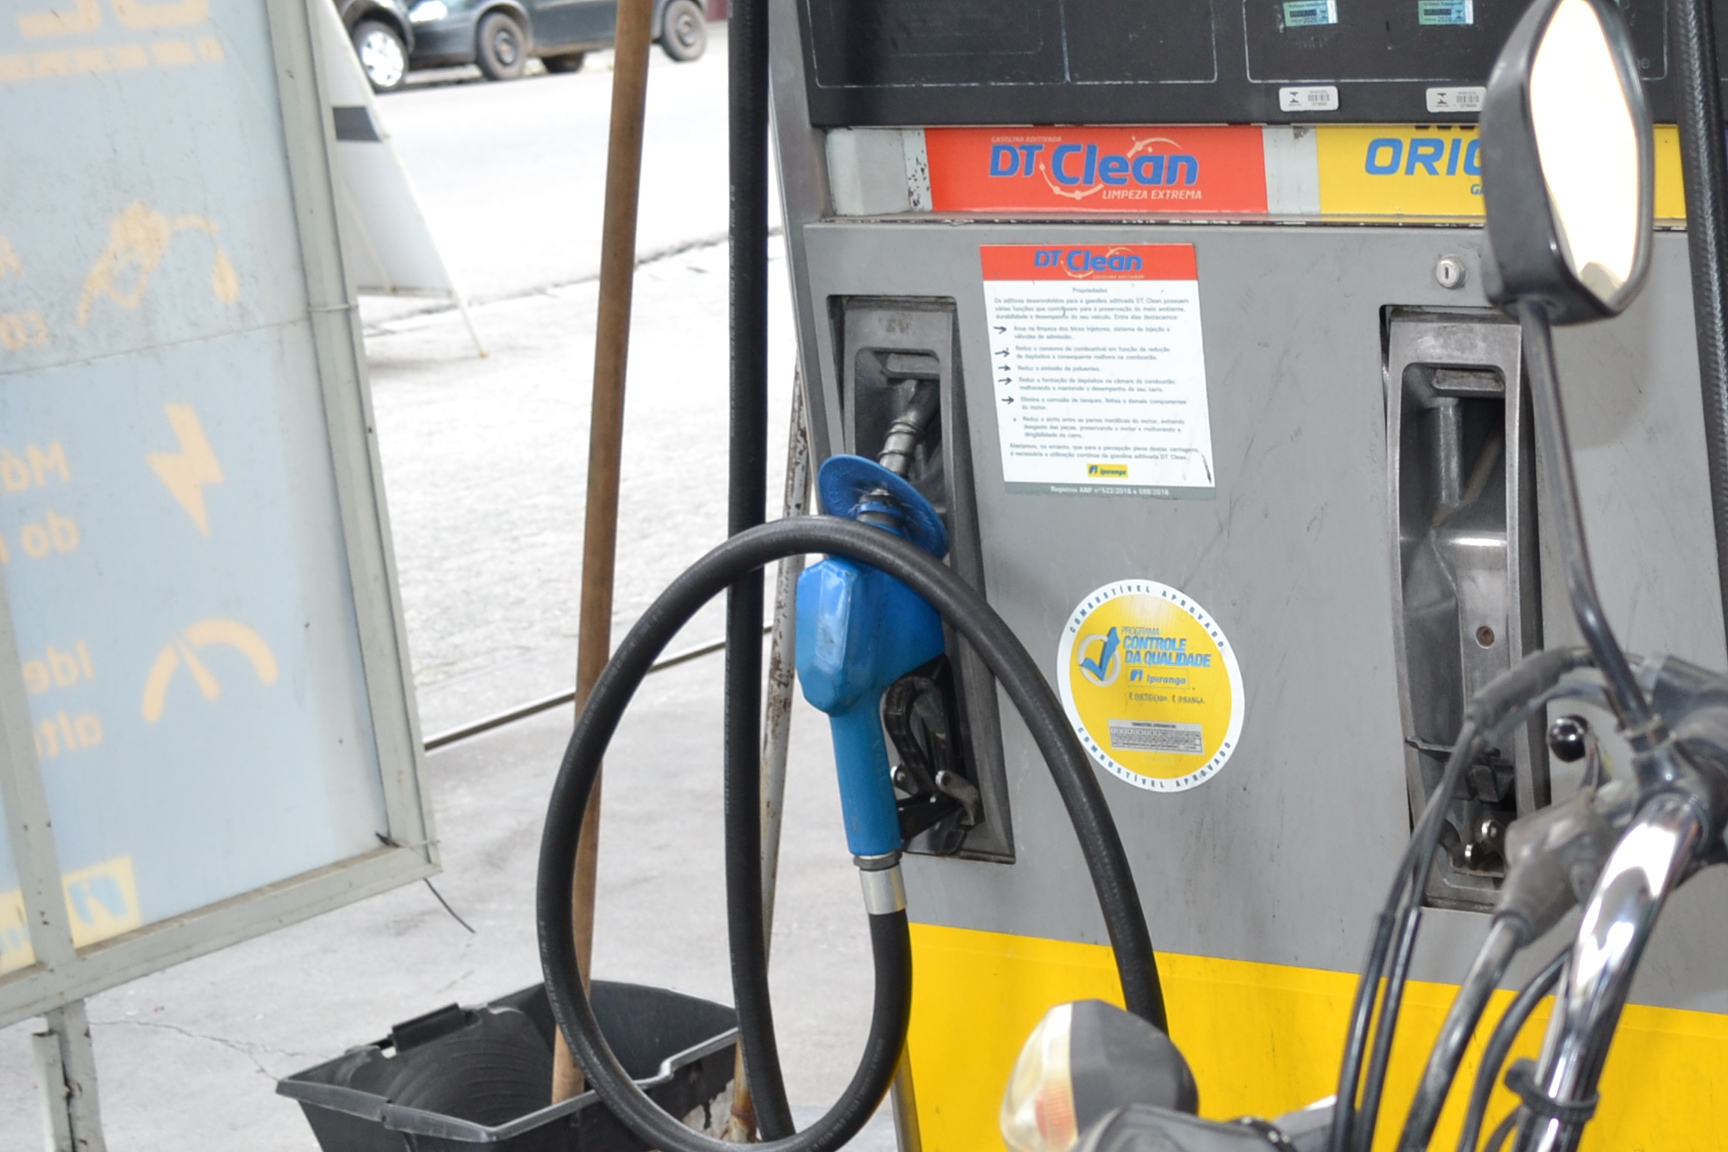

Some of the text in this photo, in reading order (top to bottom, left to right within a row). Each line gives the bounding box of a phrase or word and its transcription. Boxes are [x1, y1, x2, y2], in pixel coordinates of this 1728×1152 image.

[989, 144, 1199, 186] DT Clean
[1102, 190, 1201, 199] LIMPEZA EXTREMA
[1034, 250, 1143, 271] DT Clean
[1069, 585, 1151, 633] COMBUSTÍVEL
[1161, 590, 1225, 648] APROVADO
[1124, 636, 1187, 651] CONTROLE
[1126, 650, 1212, 668] DA QUALIDADE
[1148, 674, 1186, 685] Ipiranga
[1078, 727, 1164, 788] COMBUSTÍVEL
[1175, 742, 1231, 788] APROVADO
